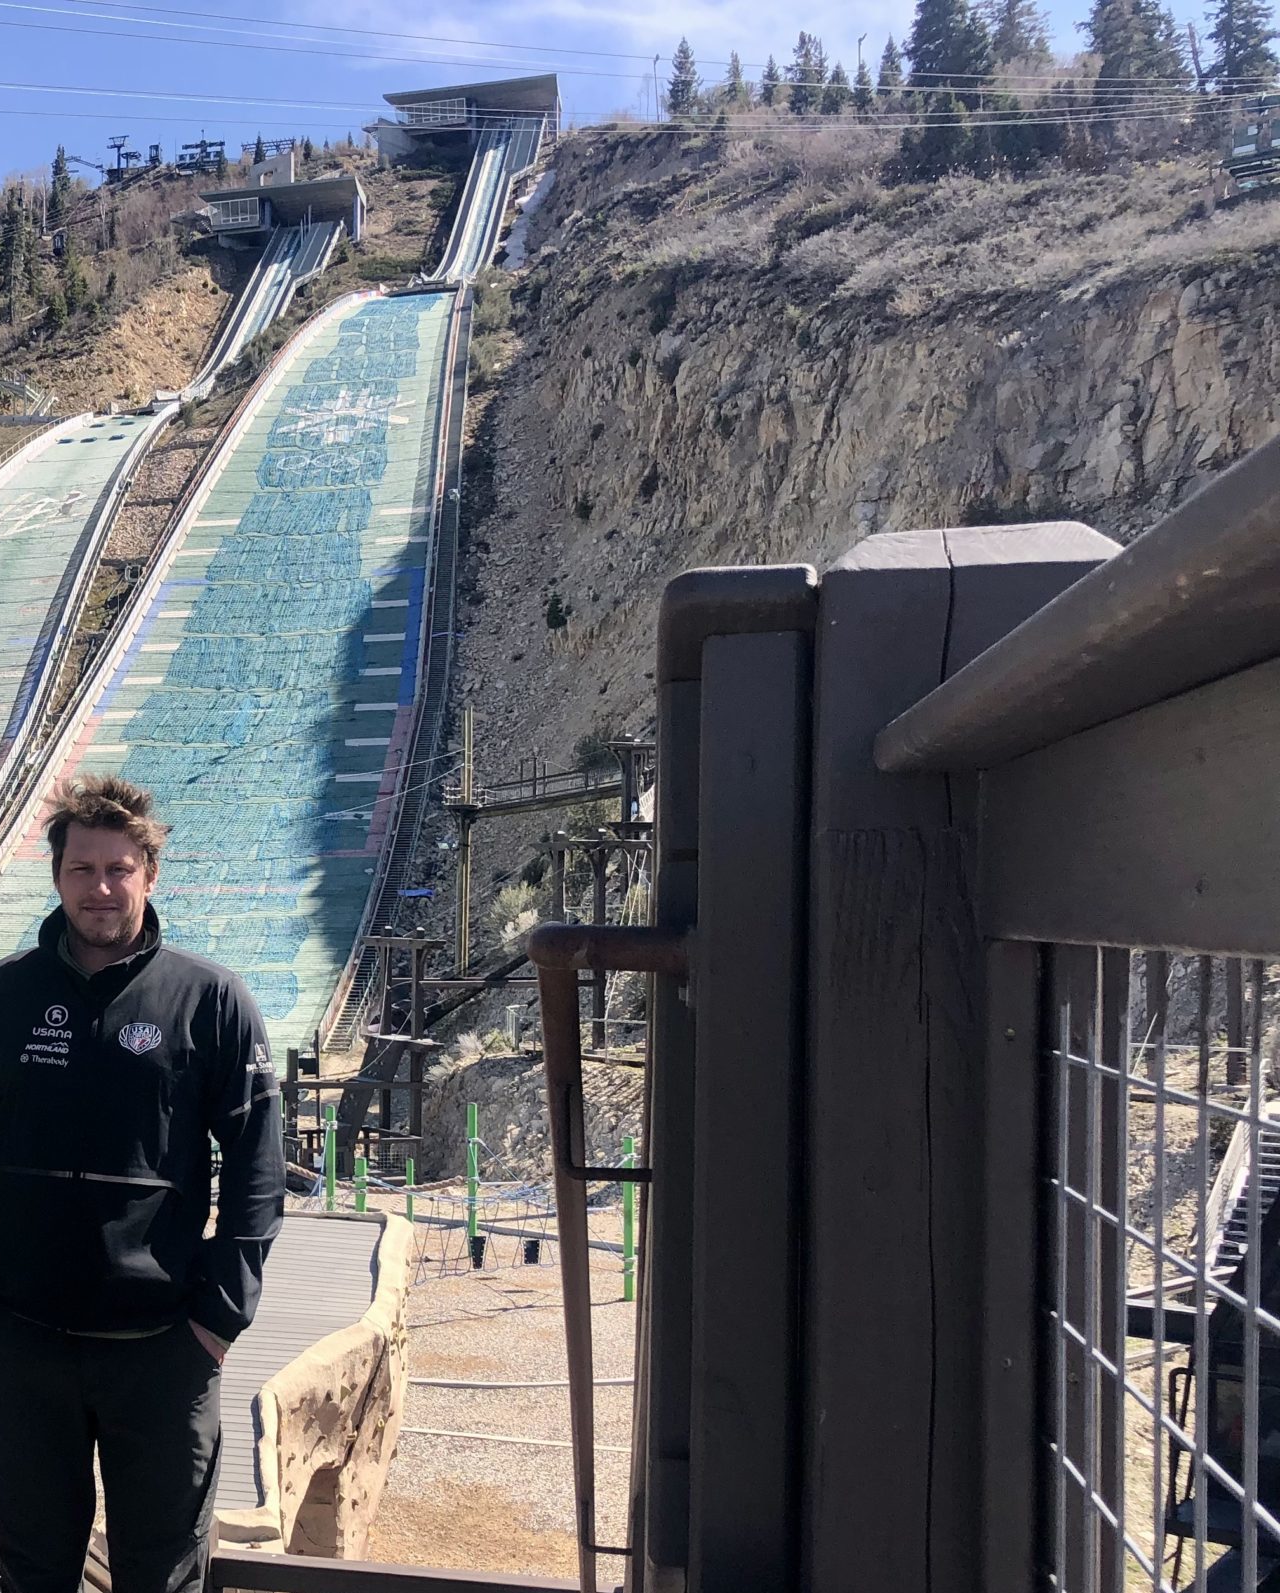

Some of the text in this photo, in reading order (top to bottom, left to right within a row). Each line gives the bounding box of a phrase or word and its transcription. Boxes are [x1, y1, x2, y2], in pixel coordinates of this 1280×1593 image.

[32, 1026, 73, 1040] USANA
[131, 1026, 150, 1035] USA
[25, 1043, 70, 1054] NORTHLAND
[31, 1054, 69, 1068] Therabody
